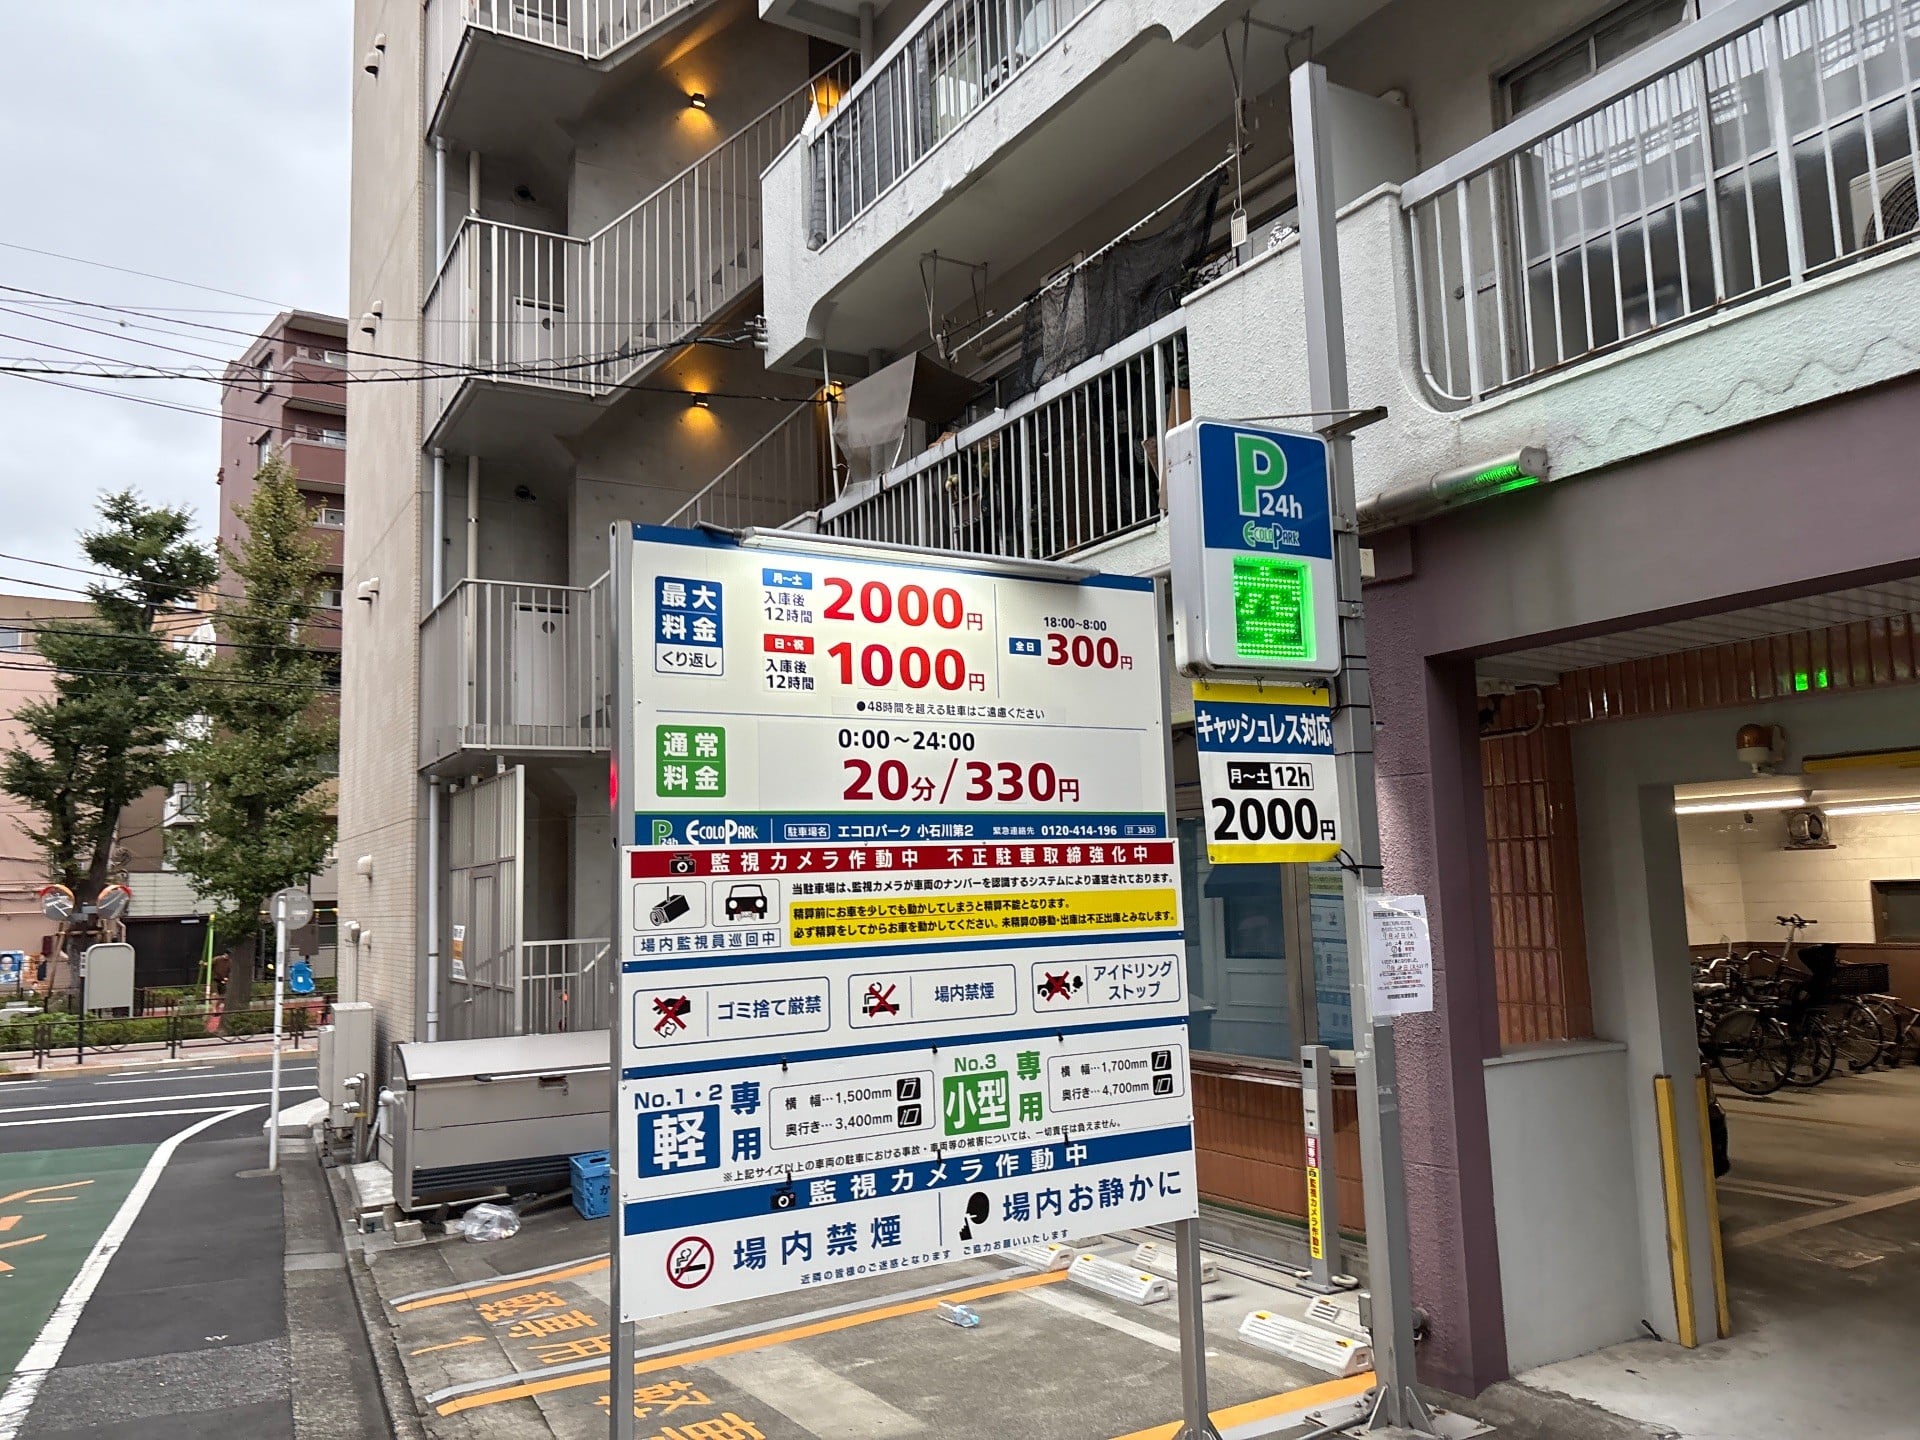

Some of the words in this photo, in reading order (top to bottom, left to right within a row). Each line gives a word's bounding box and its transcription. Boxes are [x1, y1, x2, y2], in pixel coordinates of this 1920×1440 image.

[1234, 432, 1288, 517] P
[1262, 492, 1303, 519] 24h
[661, 582, 717, 611] 最大
[764, 591, 804, 607] 入庫後
[823, 577, 983, 631] 2000円
[661, 614, 717, 643] 料金
[764, 607, 812, 623] 12時間
[662, 650, 718, 669] くり返し
[1015, 640, 1034, 653] 全日
[1047, 633, 1133, 670] 300円
[765, 658, 807, 674] 入庫後
[827, 641, 985, 692] 1000円
[765, 674, 814, 691] 12時間
[1197, 709, 1333, 747] キャッシュレス対応
[663, 732, 719, 758] 通常
[664, 765, 719, 791] 料金
[843, 758, 1080, 804] 20分/330円
[1275, 766, 1310, 787] 12h
[787, 826, 827, 838] 駐車場名
[838, 825, 910, 838] エコロパーク
[917, 825, 974, 838] 小石川第2
[992, 826, 1035, 836] 緊急連絡先
[1041, 825, 1117, 836] 0120-414-196
[1211, 797, 1336, 841] 2000円
[709, 849, 918, 873] 監視カメラ作動中
[947, 845, 1148, 867] 不正駐車取締強化中
[640, 931, 776, 953] 場内監視員巡回中
[1093, 960, 1172, 981] アイドリング
[934, 982, 995, 1003] 場内禁煙
[1108, 981, 1160, 1001] ストップ
[717, 994, 822, 1021] ゴミ捨て厳禁
[954, 1053, 997, 1072] No.3
[1016, 1050, 1043, 1123] 専用
[945, 1076, 1009, 1128] 小型
[730, 1081, 761, 1162] 専用
[652, 1111, 706, 1170] 軽
[809, 1143, 1088, 1206] 監視カメラ作動中
[1002, 1170, 1182, 1223] 場内お静かに
[732, 1214, 902, 1271] 場内禁煙
